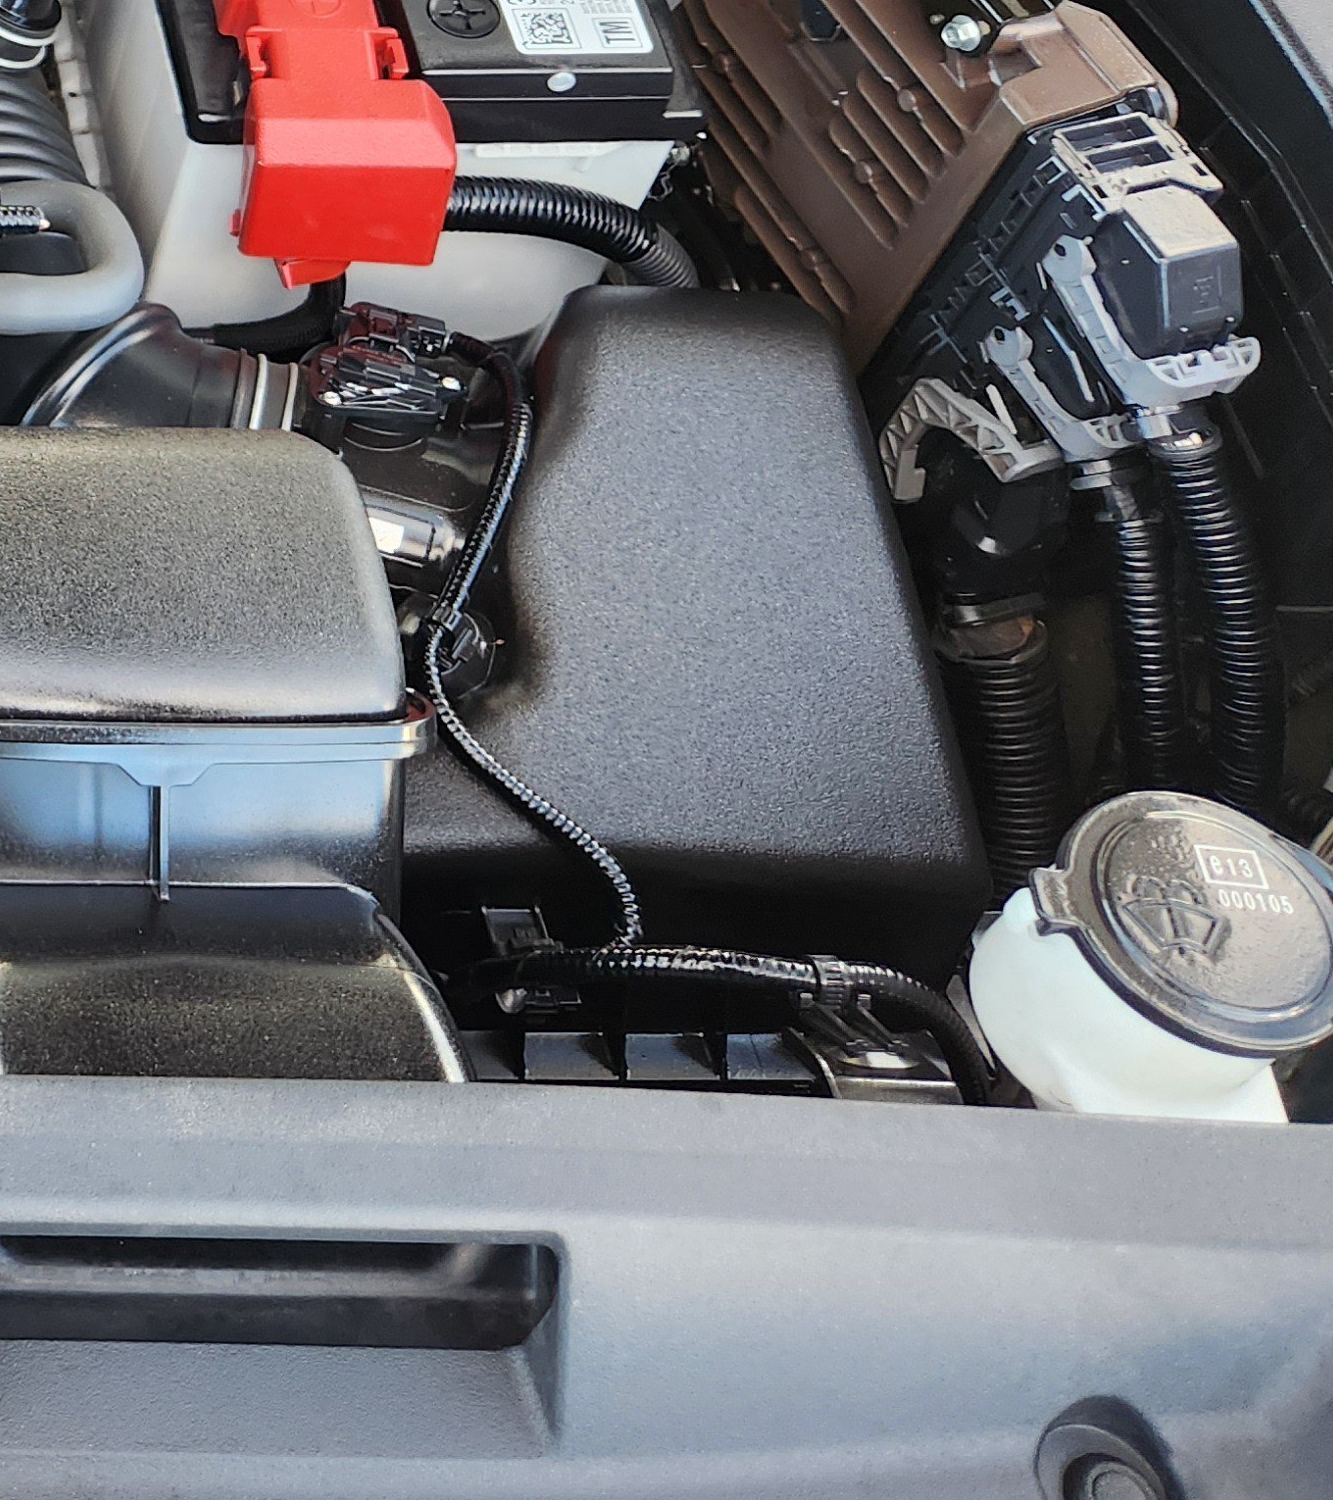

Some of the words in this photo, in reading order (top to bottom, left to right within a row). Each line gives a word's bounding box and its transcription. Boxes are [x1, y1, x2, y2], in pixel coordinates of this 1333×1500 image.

[598, 20, 636, 44] TM
[1208, 855, 1254, 879] e13
[1218, 888, 1294, 915] 000105
